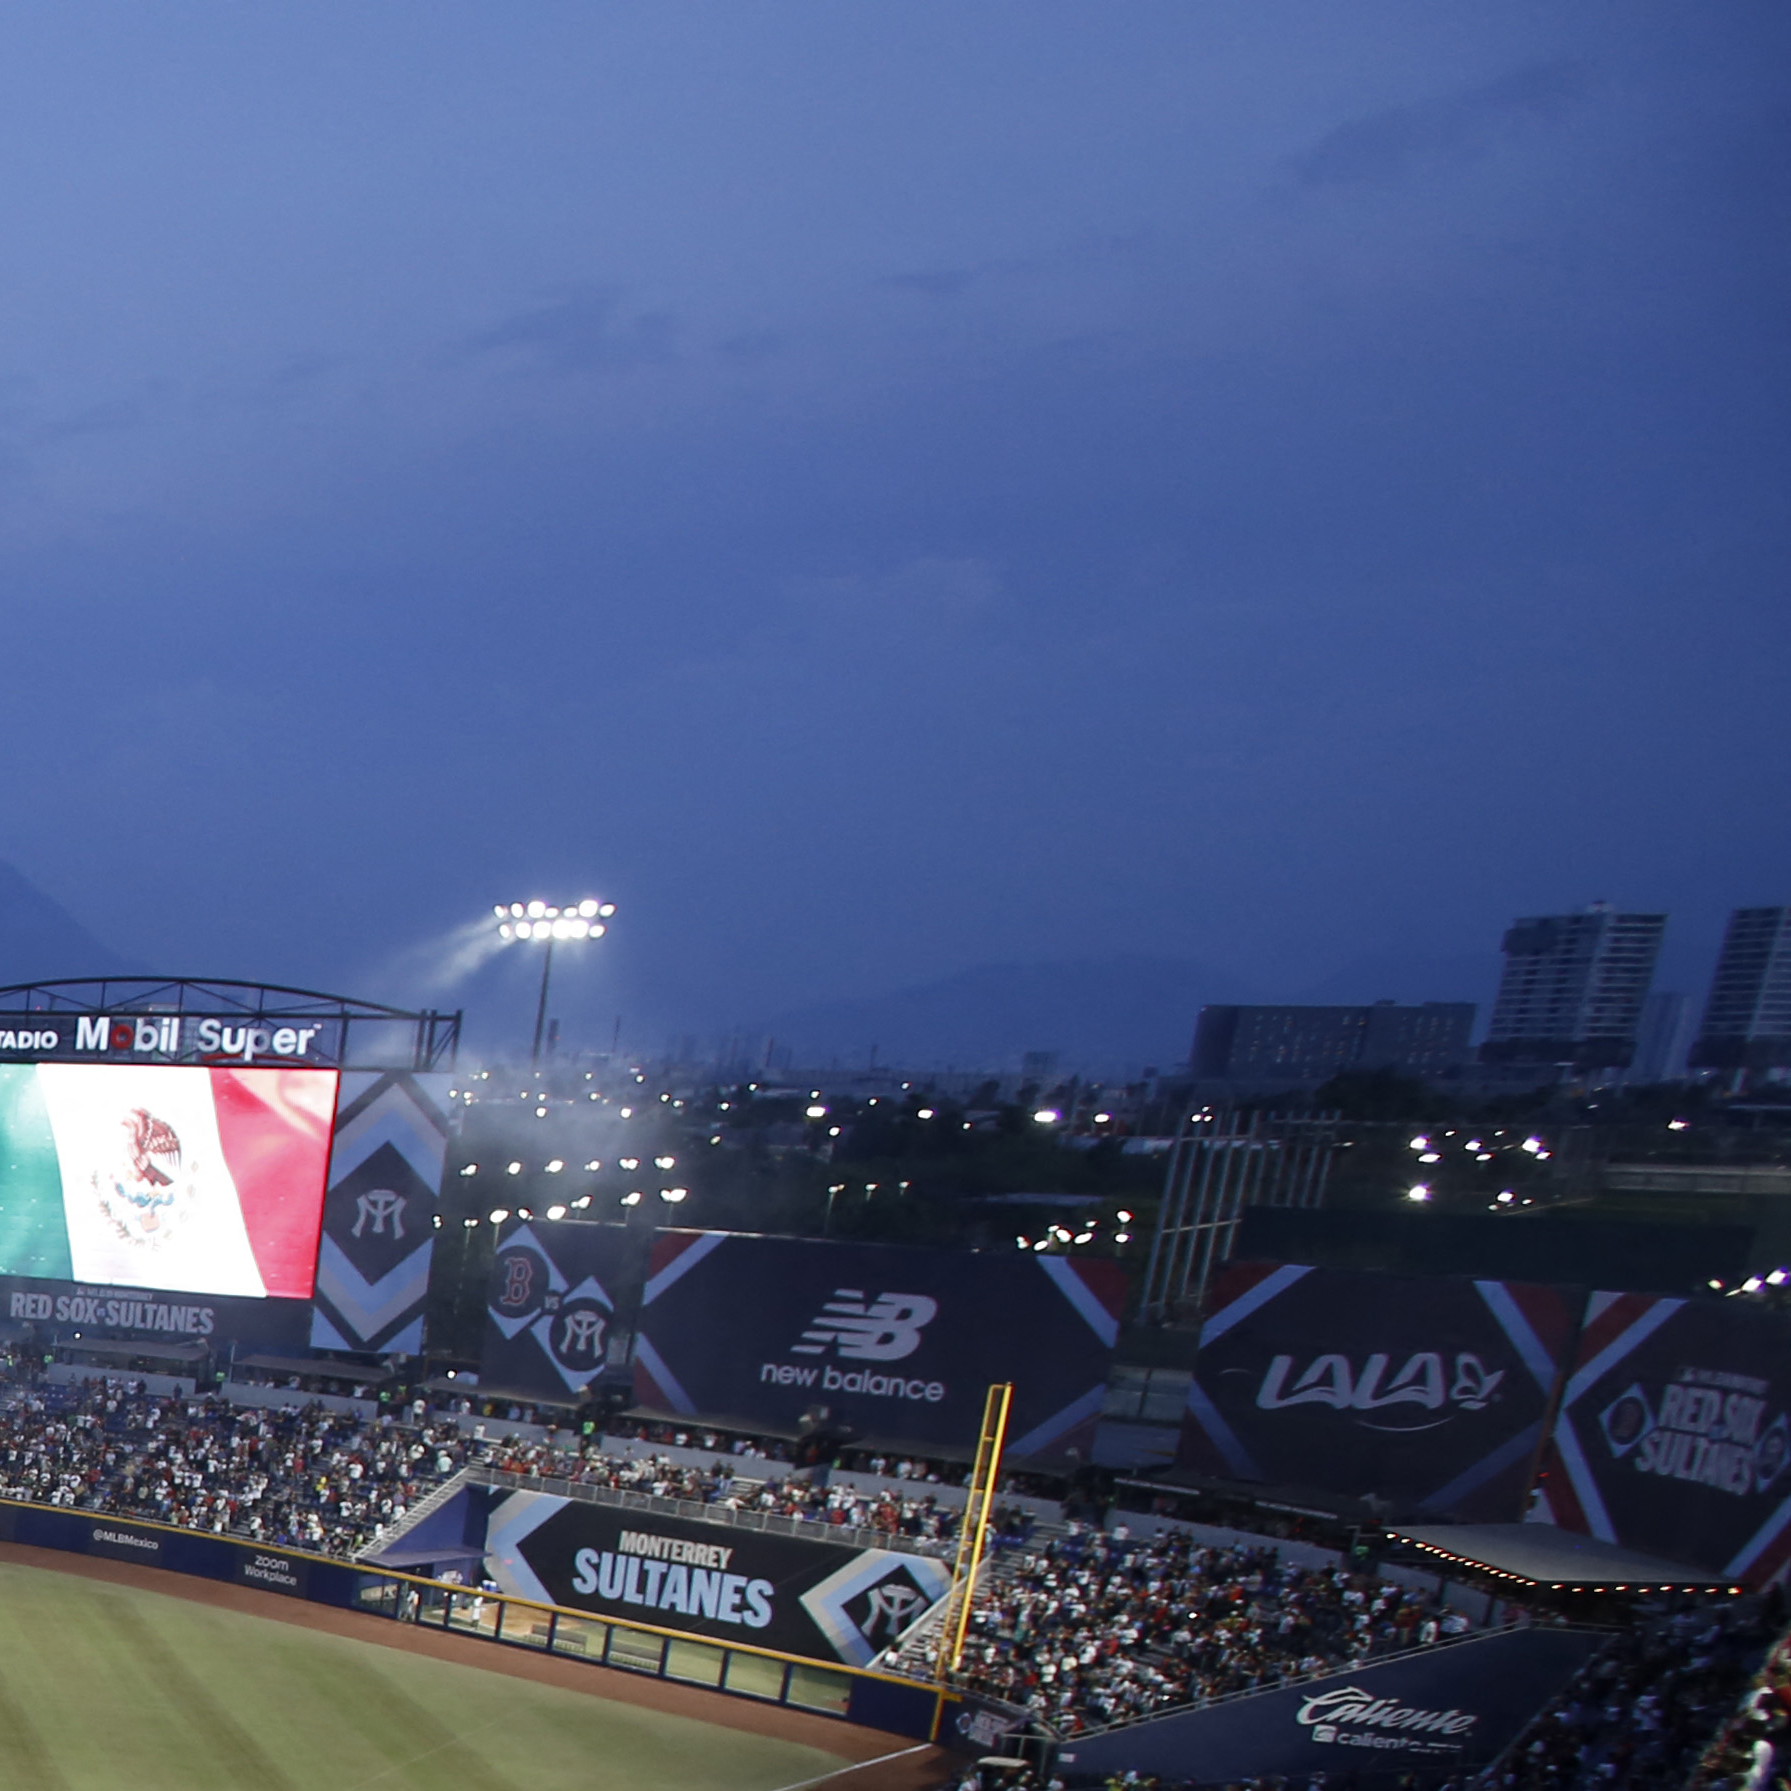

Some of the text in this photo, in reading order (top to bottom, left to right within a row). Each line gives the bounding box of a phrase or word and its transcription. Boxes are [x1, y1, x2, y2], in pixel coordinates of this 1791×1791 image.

[75, 1017, 179, 1051] Mobil
[197, 1018, 315, 1061] Super
[10, 1291, 53, 1320] RED
[55, 1295, 99, 1325] SOX
[105, 1300, 215, 1335] SULTANES
[760, 1362, 944, 1402] new balance
[1256, 1352, 1446, 1410] LALA
[93, 1528, 159, 1550] @MLBMexico
[618, 1530, 734, 1570] MONTERREY
[244, 1564, 297, 1586] Workplace
[254, 1554, 289, 1572] zoom
[572, 1547, 775, 1628] SULTANES
[1296, 1685, 1478, 1735] Caliente
